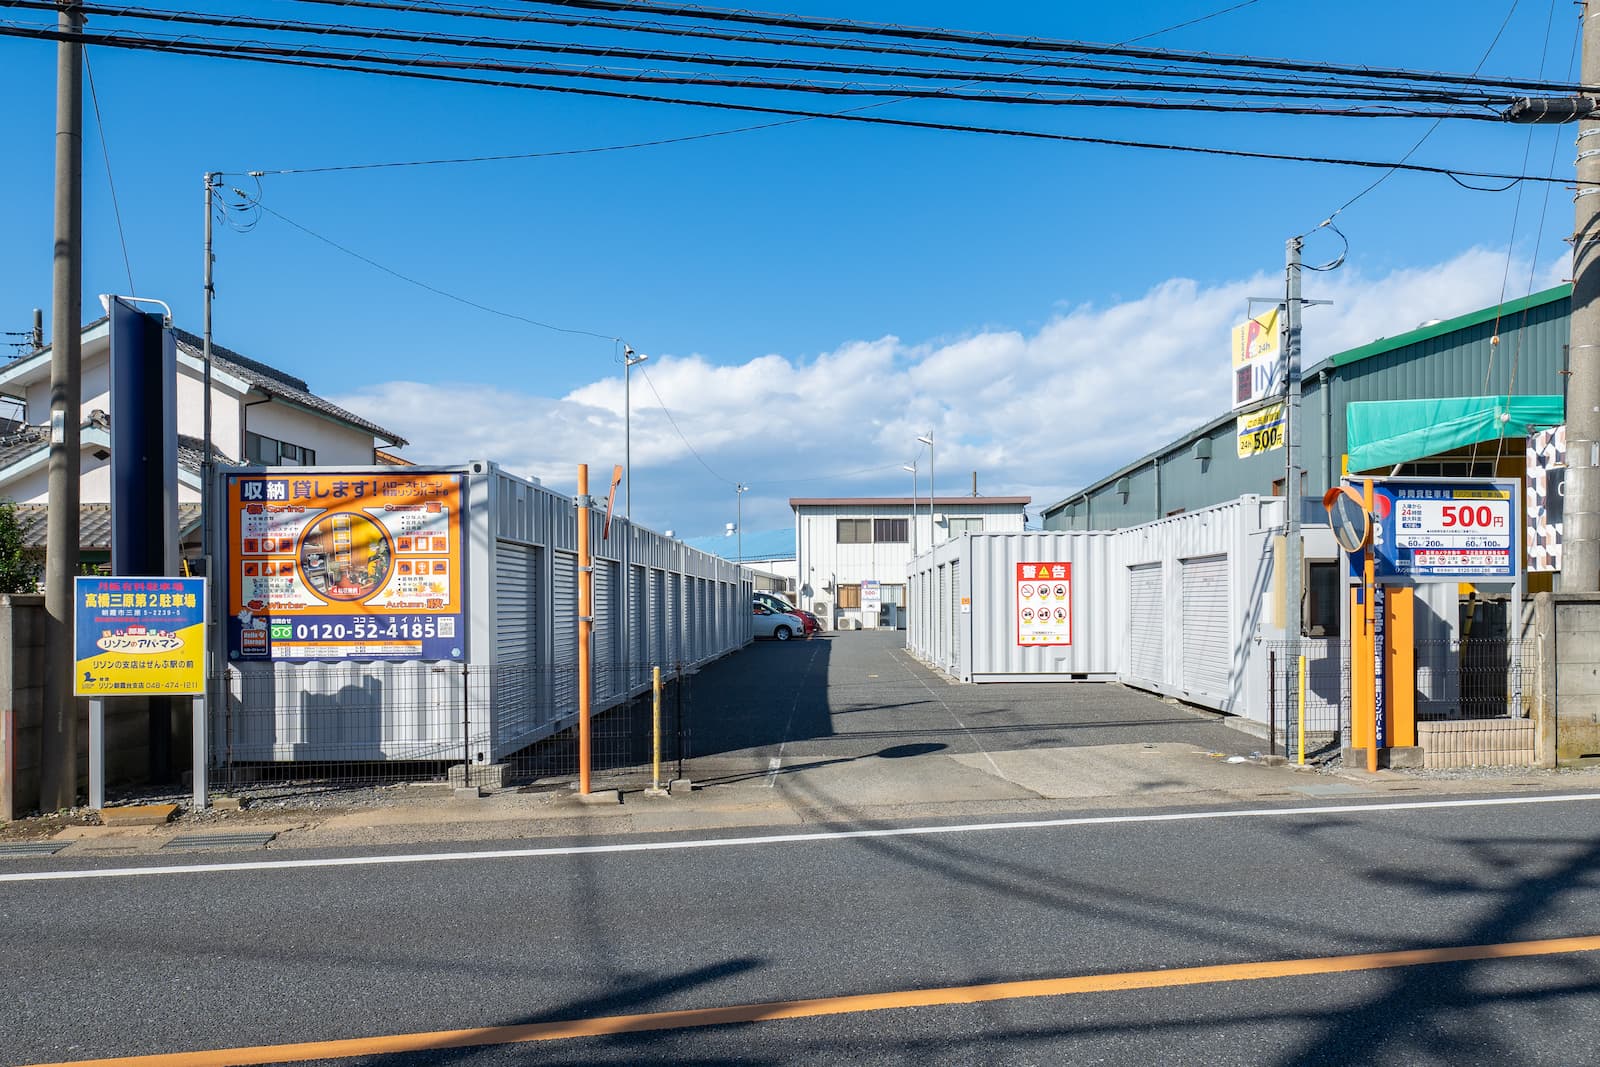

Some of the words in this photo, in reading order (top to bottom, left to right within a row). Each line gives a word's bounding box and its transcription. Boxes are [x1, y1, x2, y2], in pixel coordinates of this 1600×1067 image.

[1255, 362, 1273, 391] IN
[244, 481, 286, 500] 収納
[383, 481, 442, 489] ハローストレージ
[1398, 489, 1451, 499] 時間貸駐車場
[266, 505, 306, 513] Spring
[1442, 505, 1504, 528] 500円
[296, 623, 435, 639] 0120-52-4185
[93, 660, 195, 669] リゾンの支店はぜんぶ駅の前
